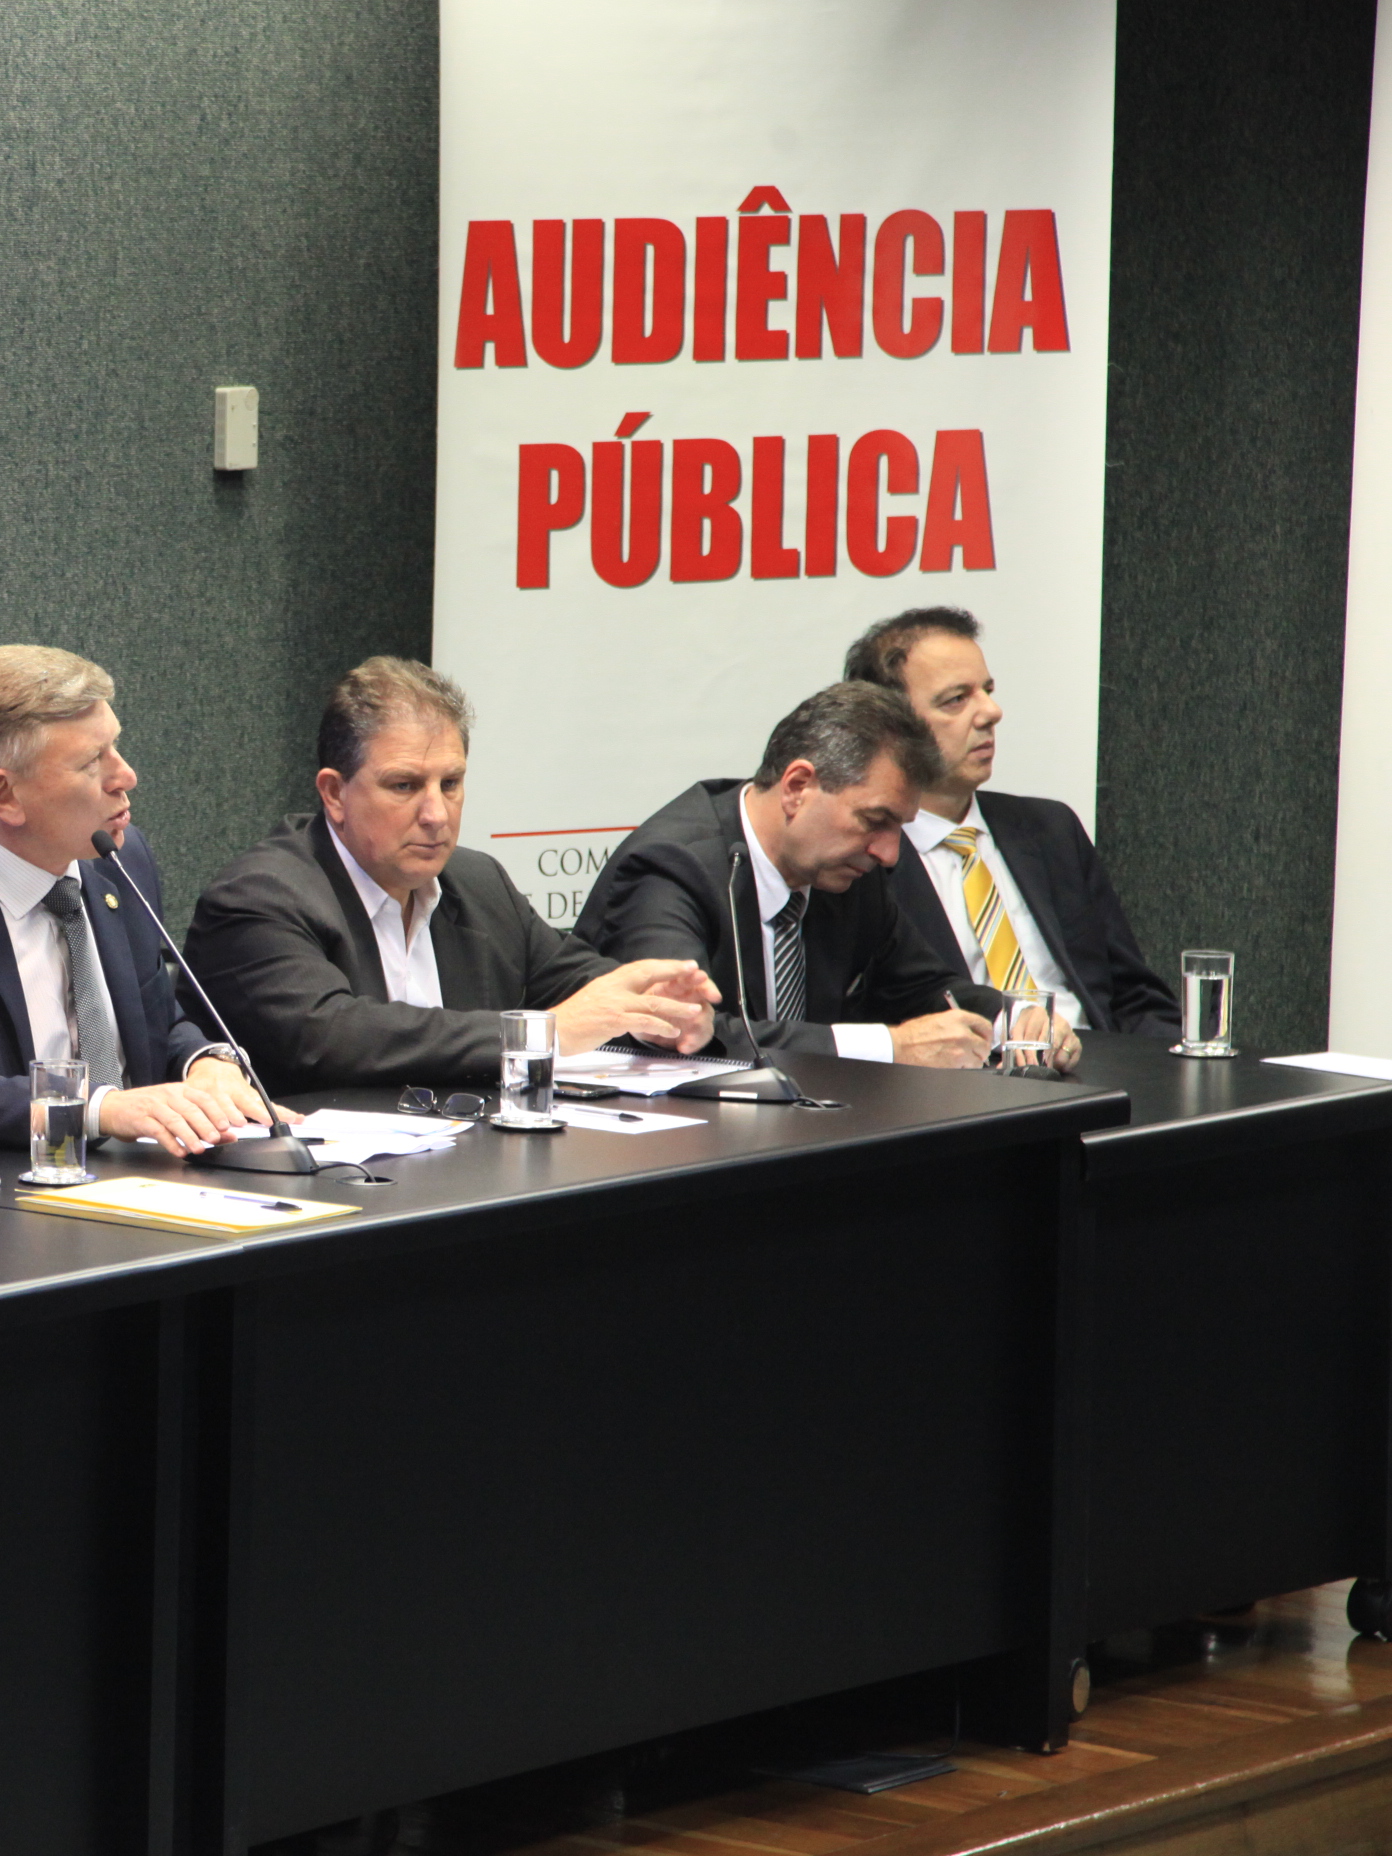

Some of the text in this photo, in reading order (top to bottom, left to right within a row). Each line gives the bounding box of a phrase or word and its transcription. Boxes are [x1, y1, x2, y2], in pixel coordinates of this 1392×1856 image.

[454, 185, 1070, 369] AUDIÊNCIA
[516, 411, 995, 589] PÚBLICA
[537, 846, 617, 877] COM
[547, 890, 584, 919] DE
